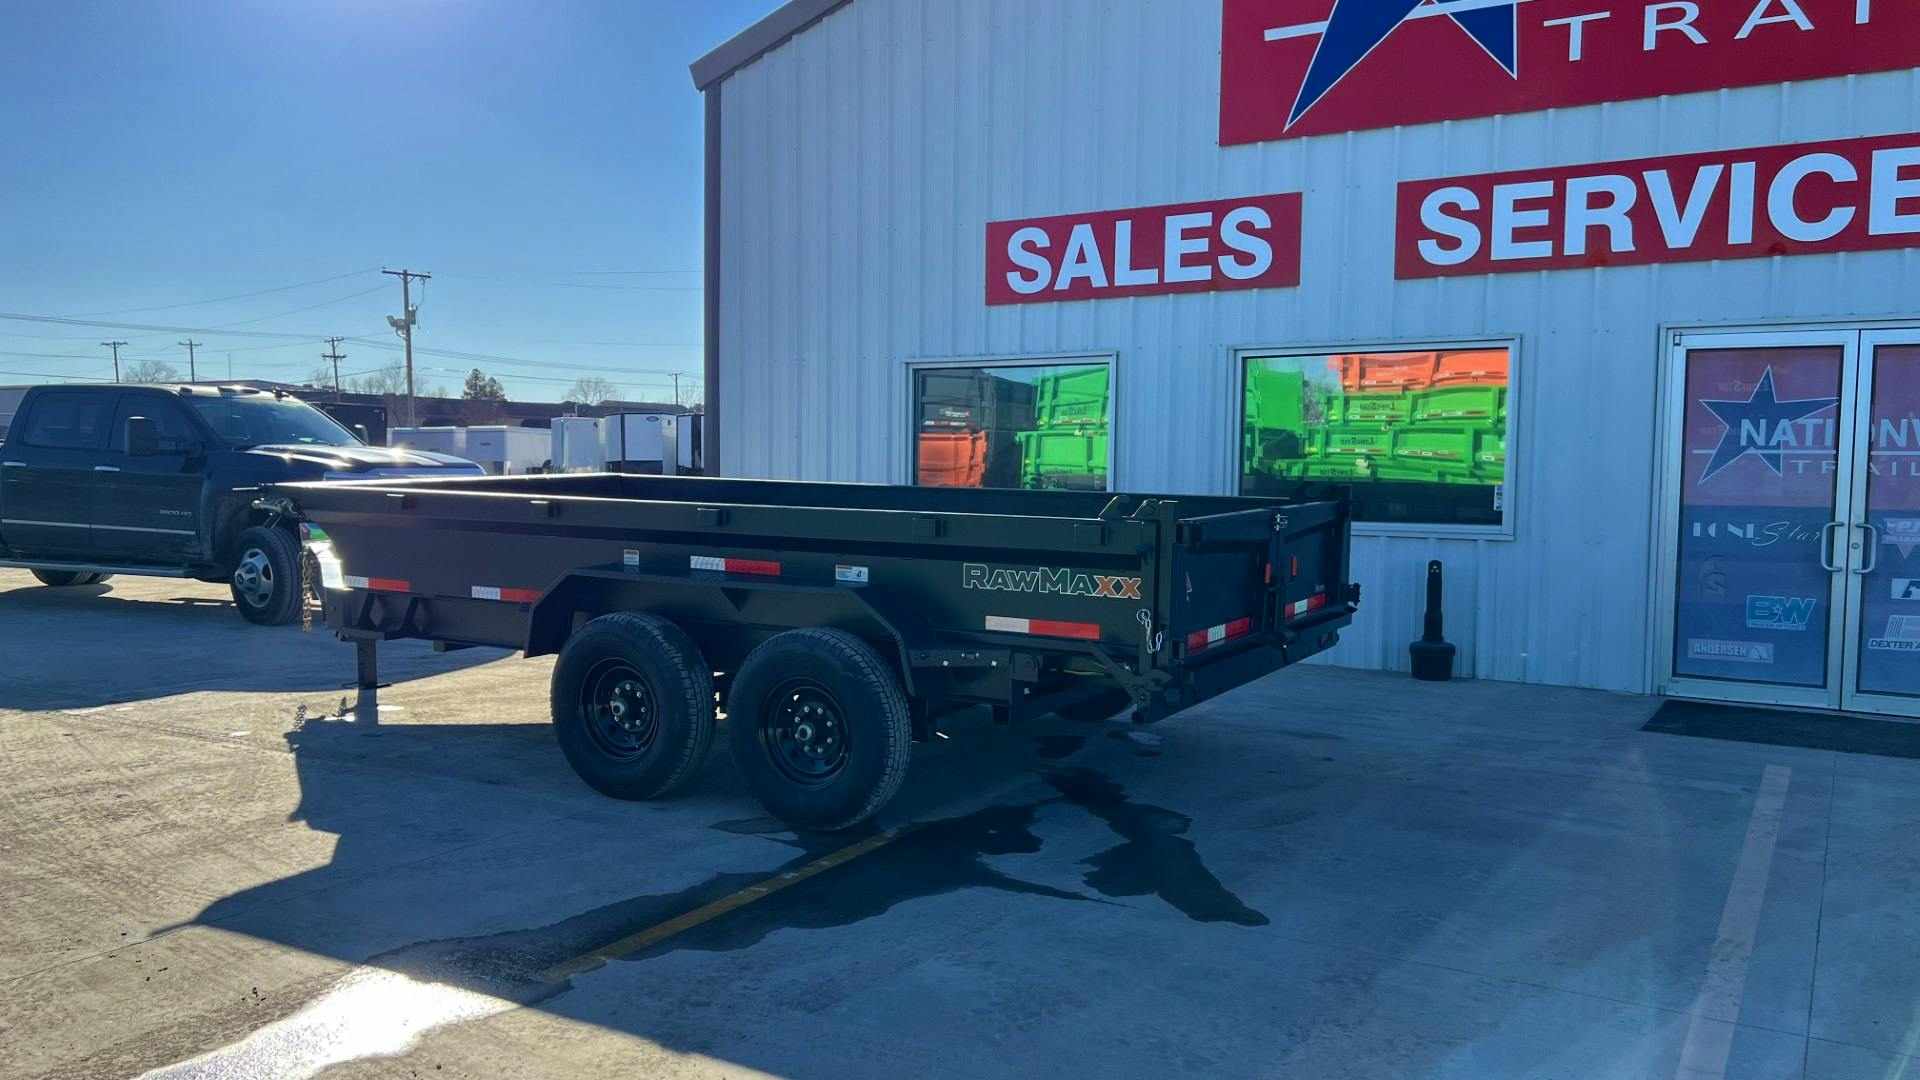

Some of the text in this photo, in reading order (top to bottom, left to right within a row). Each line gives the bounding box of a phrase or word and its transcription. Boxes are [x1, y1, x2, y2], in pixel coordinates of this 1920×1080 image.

[1417, 146, 1920, 266] SERVICE
[1006, 206, 1273, 295] SALES
[1693, 642, 1747, 658] ANDERSEN
[1870, 639, 1914, 650] DEXTER
